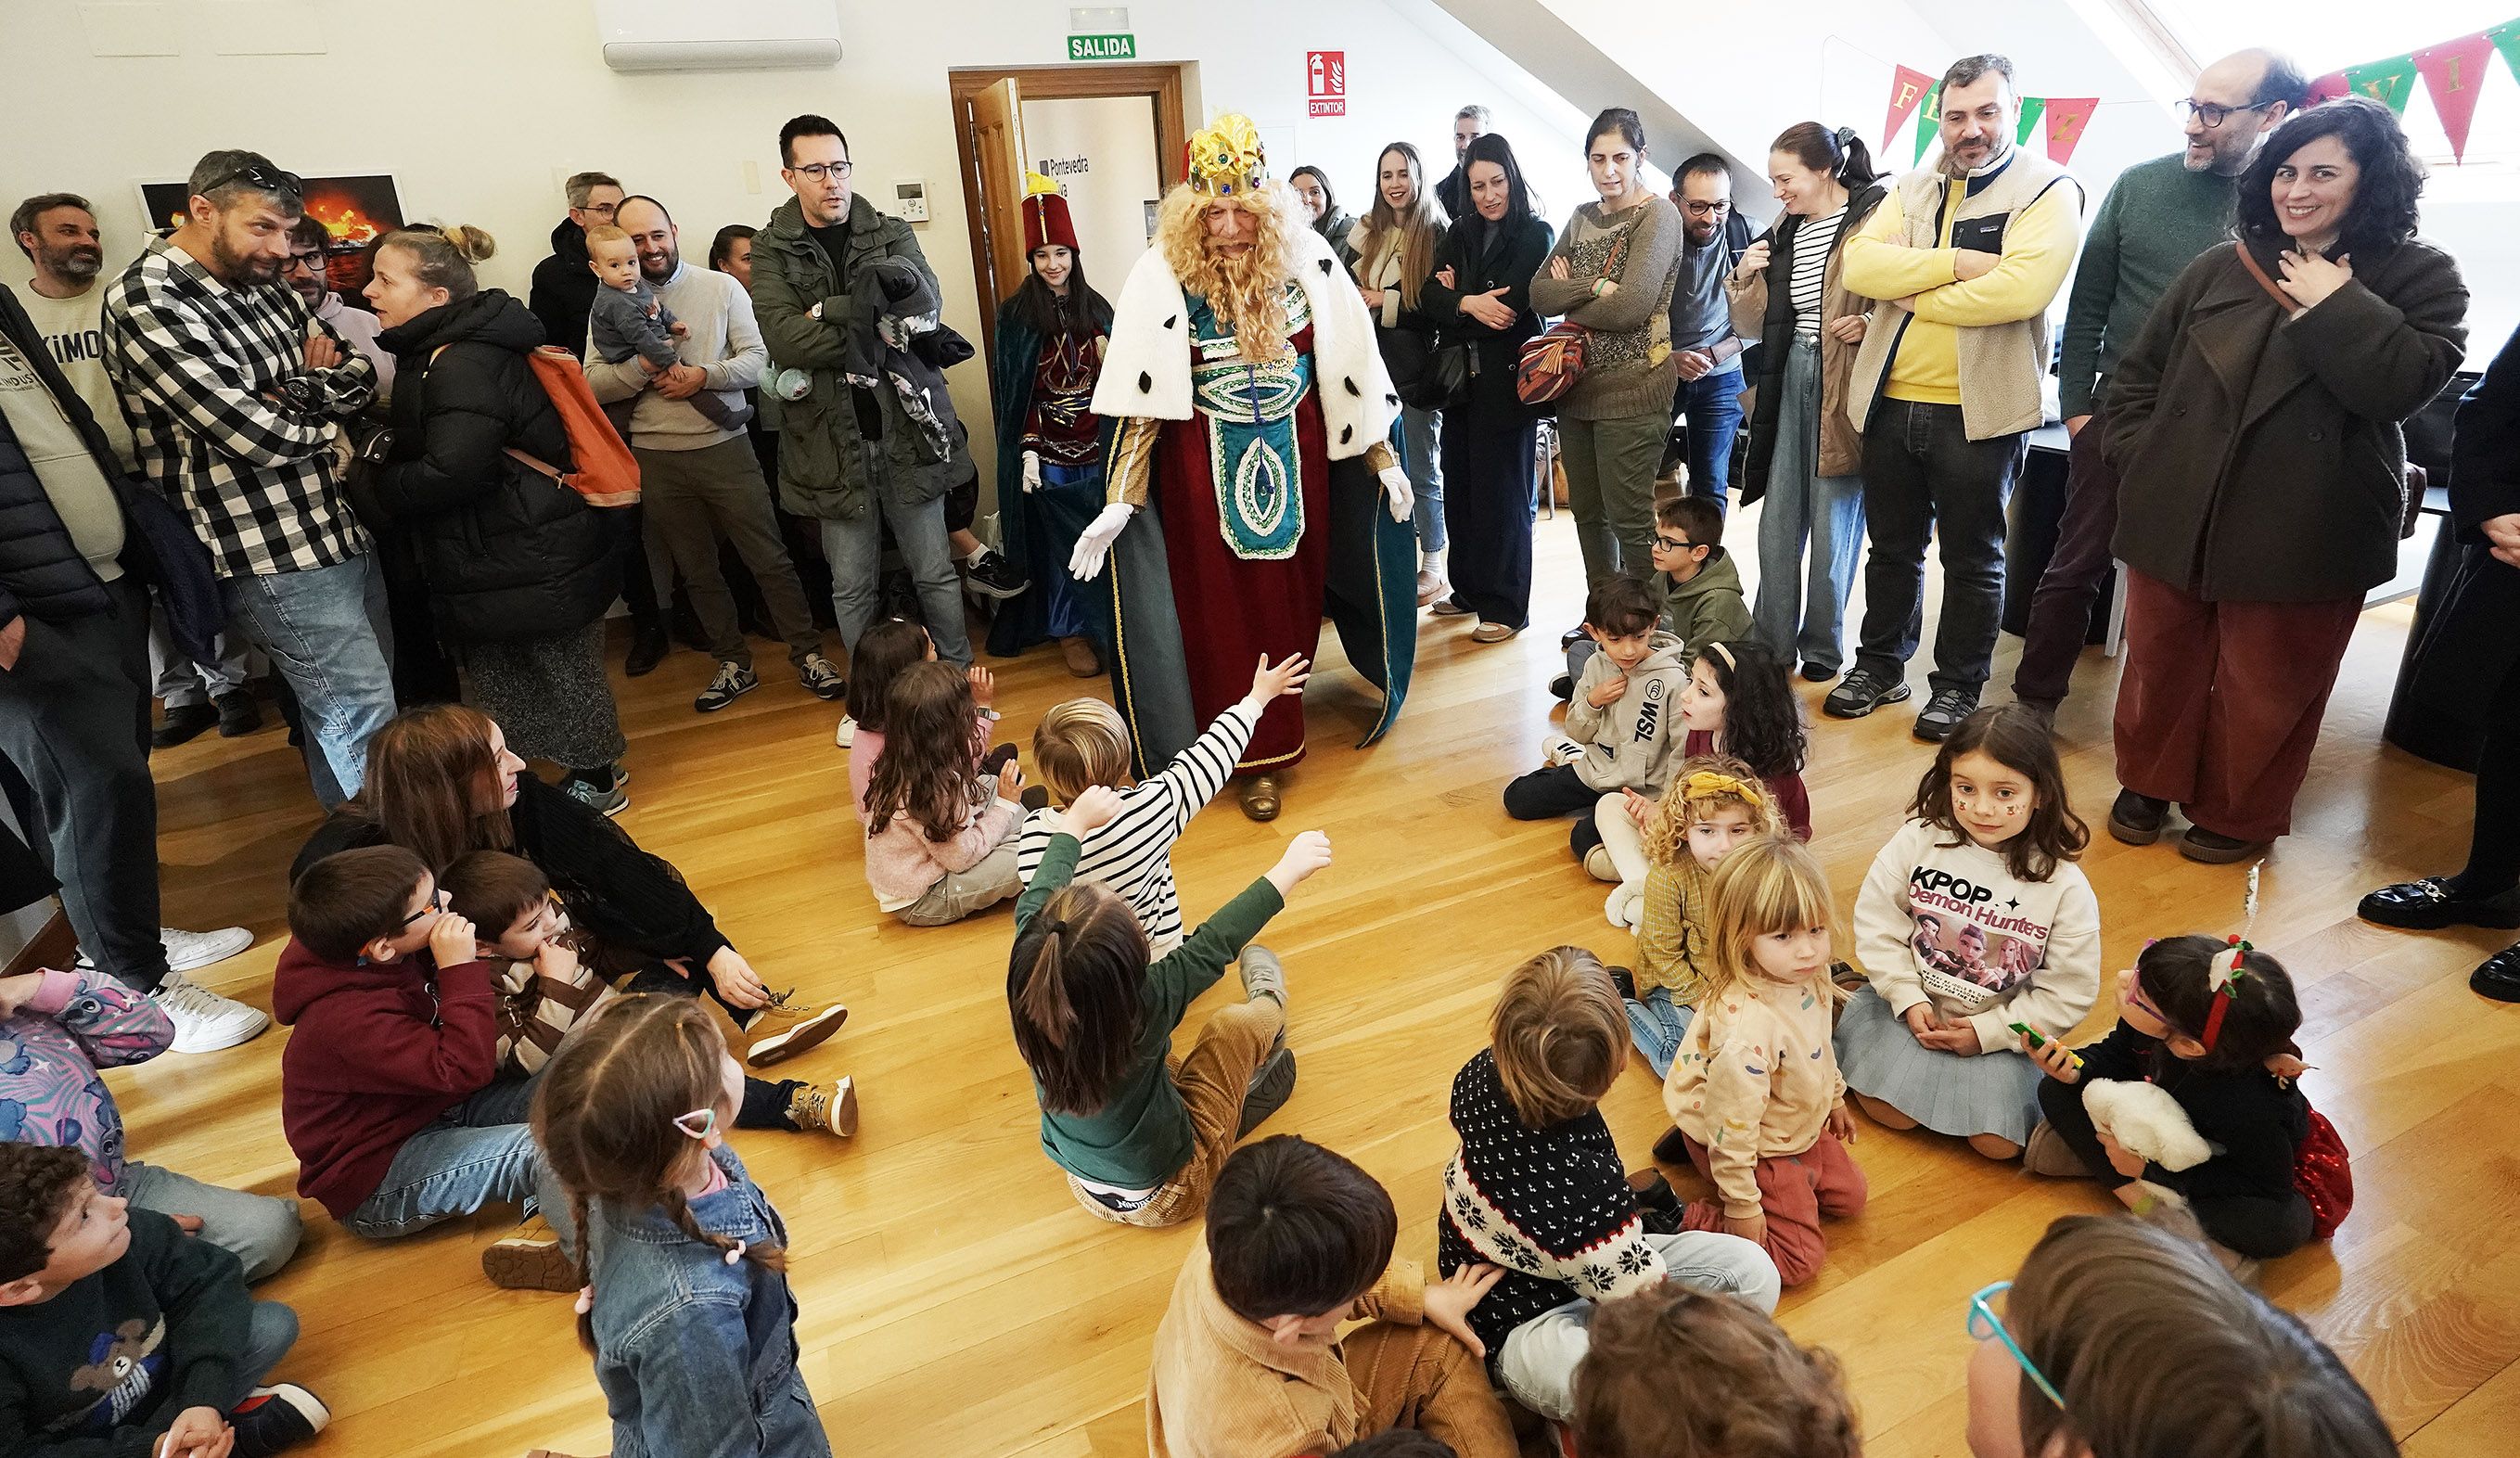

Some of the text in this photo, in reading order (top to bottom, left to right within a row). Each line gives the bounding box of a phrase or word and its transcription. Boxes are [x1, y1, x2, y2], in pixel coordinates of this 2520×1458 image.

[1072, 37, 1132, 57] SALIDA
[1310, 102, 1344, 114] EXTINTOR
[1050, 154, 1089, 176] Pontevedra
[1633, 701, 1659, 743] WSL
[1911, 865, 1992, 905] KPOP
[1908, 883, 2049, 940] Demon Hunters
